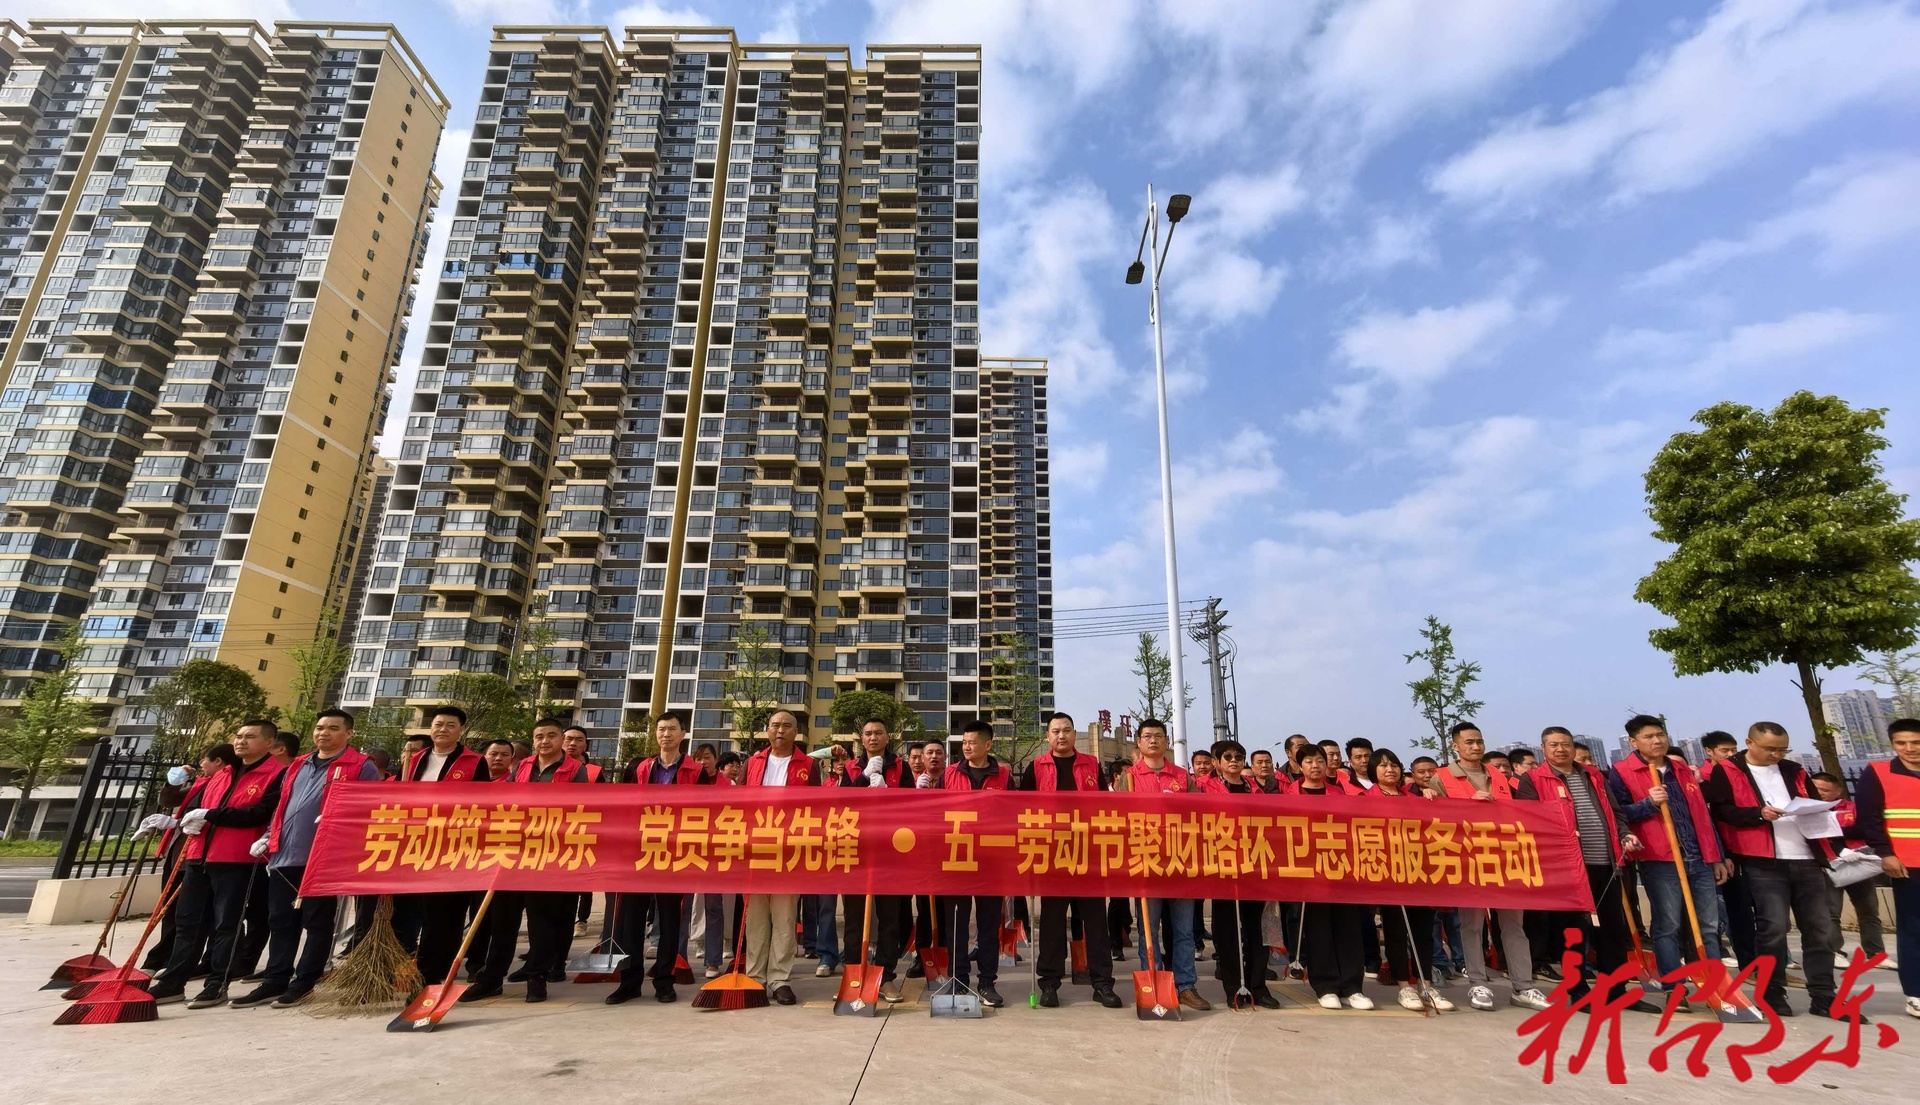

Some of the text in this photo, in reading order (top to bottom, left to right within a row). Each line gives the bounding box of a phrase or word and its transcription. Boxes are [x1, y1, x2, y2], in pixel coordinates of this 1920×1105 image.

[357, 803, 1545, 888] 劳动筑美邵东 党员争当先锋 五一劳动节聚财路环卫志愿服务活动
